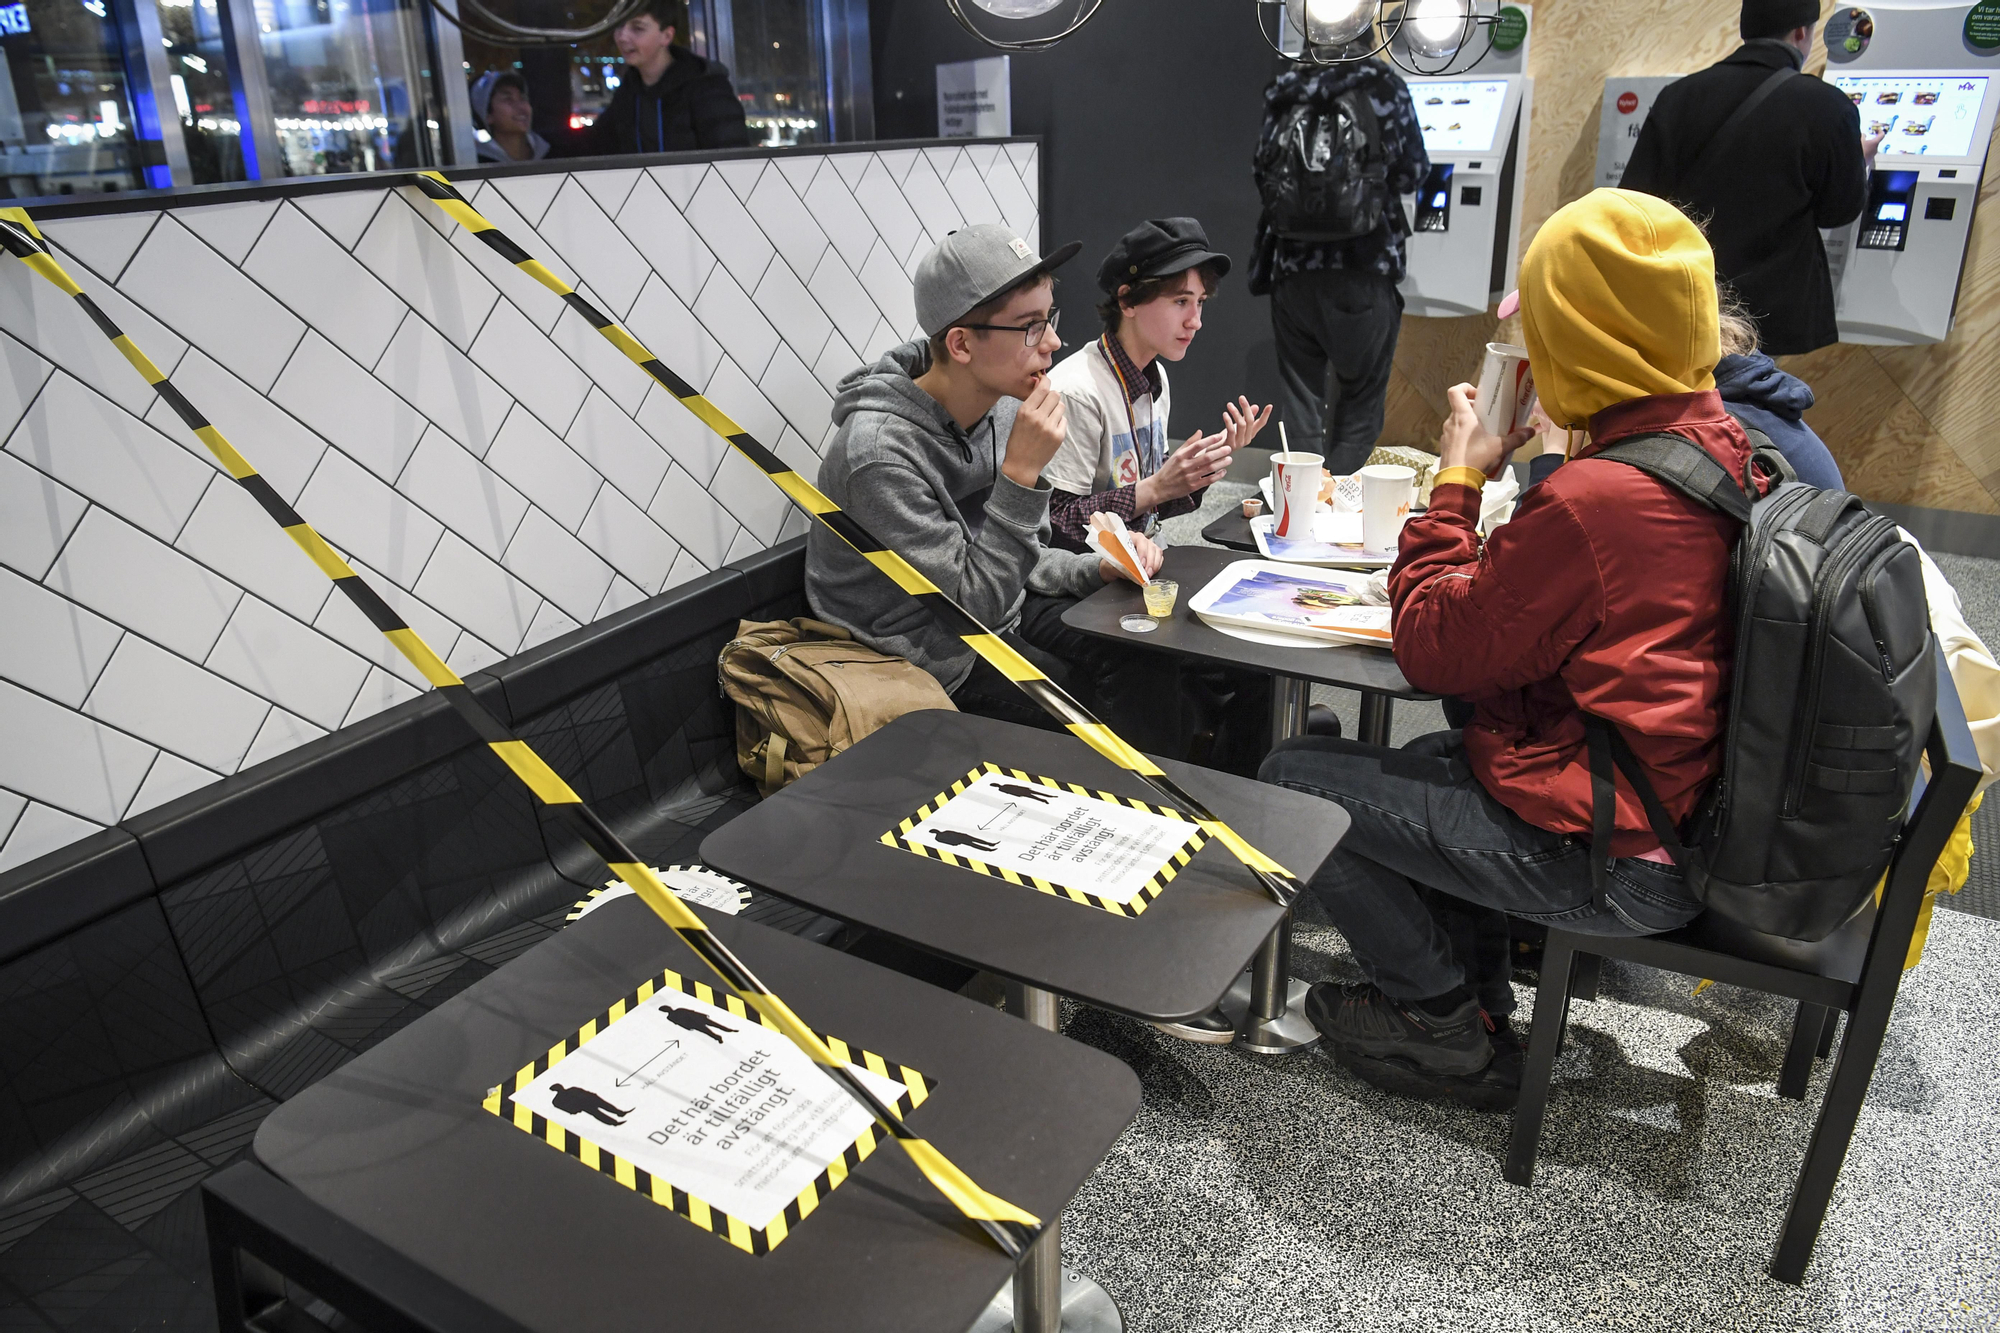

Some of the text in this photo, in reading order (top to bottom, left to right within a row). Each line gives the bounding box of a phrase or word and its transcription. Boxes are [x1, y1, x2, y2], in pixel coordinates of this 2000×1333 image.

[1957, 82, 1976, 91] MAX
[1396, 500, 1411, 517] MA
[1018, 807, 1089, 861] Det här bordet
[1044, 817, 1101, 861] är tillfälligt
[1071, 827, 1117, 863] avstängt.
[1432, 1025, 1467, 1039] salomon
[647, 1050, 771, 1146] Det här bordet
[682, 1068, 781, 1146] är tillfälligt
[716, 1087, 796, 1150] avstängt.
[744, 1143, 762, 1155] För
[772, 1099, 812, 1131] förhindra
[734, 1133, 797, 1187] smittspridning
[793, 1121, 808, 1132] har
[752, 1159, 789, 1190] minskat
